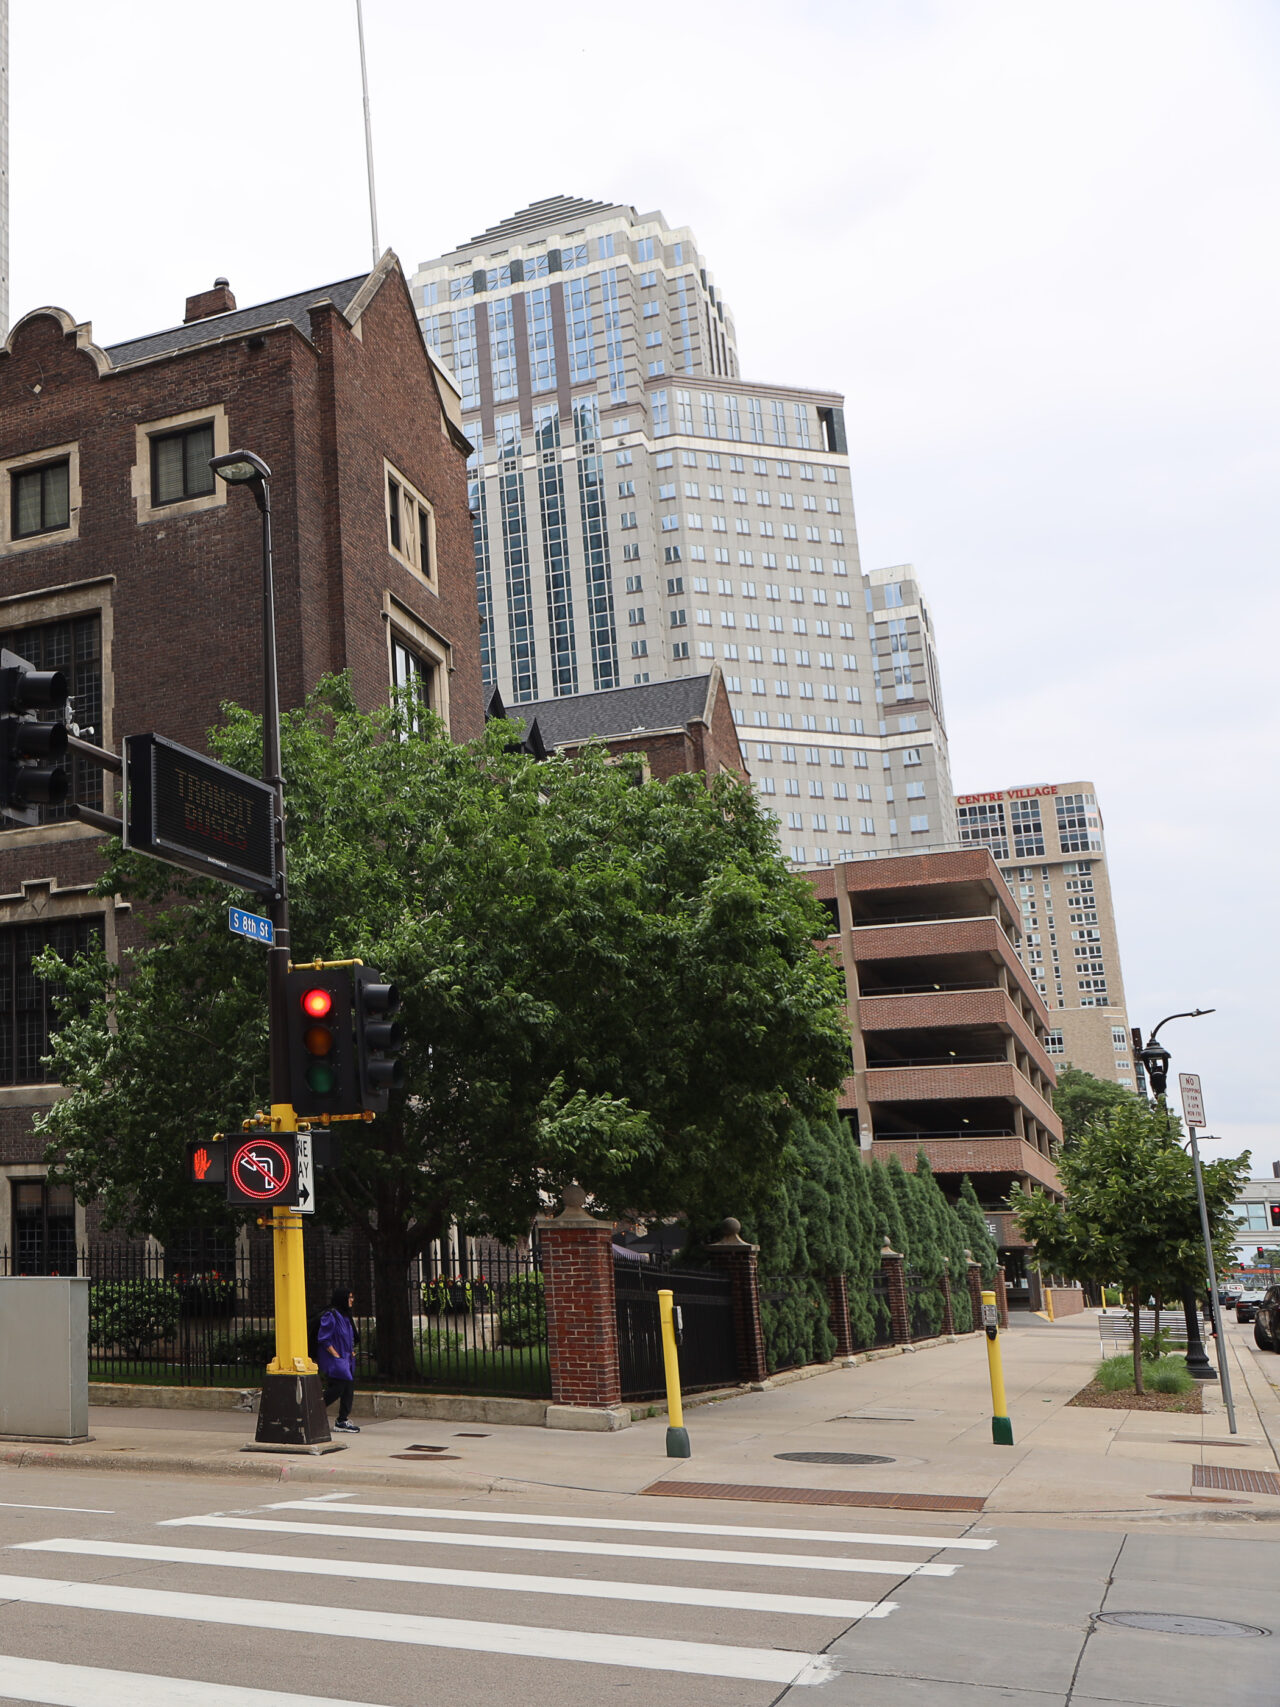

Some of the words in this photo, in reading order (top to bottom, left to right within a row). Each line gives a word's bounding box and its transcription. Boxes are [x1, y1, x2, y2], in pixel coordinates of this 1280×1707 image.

[175, 768, 255, 825] TRANSIT
[957, 791, 1004, 805] CENTRE
[1007, 785, 1058, 799] VILLAGE
[233, 912, 239, 928] S
[242, 916, 257, 934] 8th
[260, 921, 269, 938] St
[297, 1140, 308, 1157] NE
[298, 1161, 309, 1178] AY
